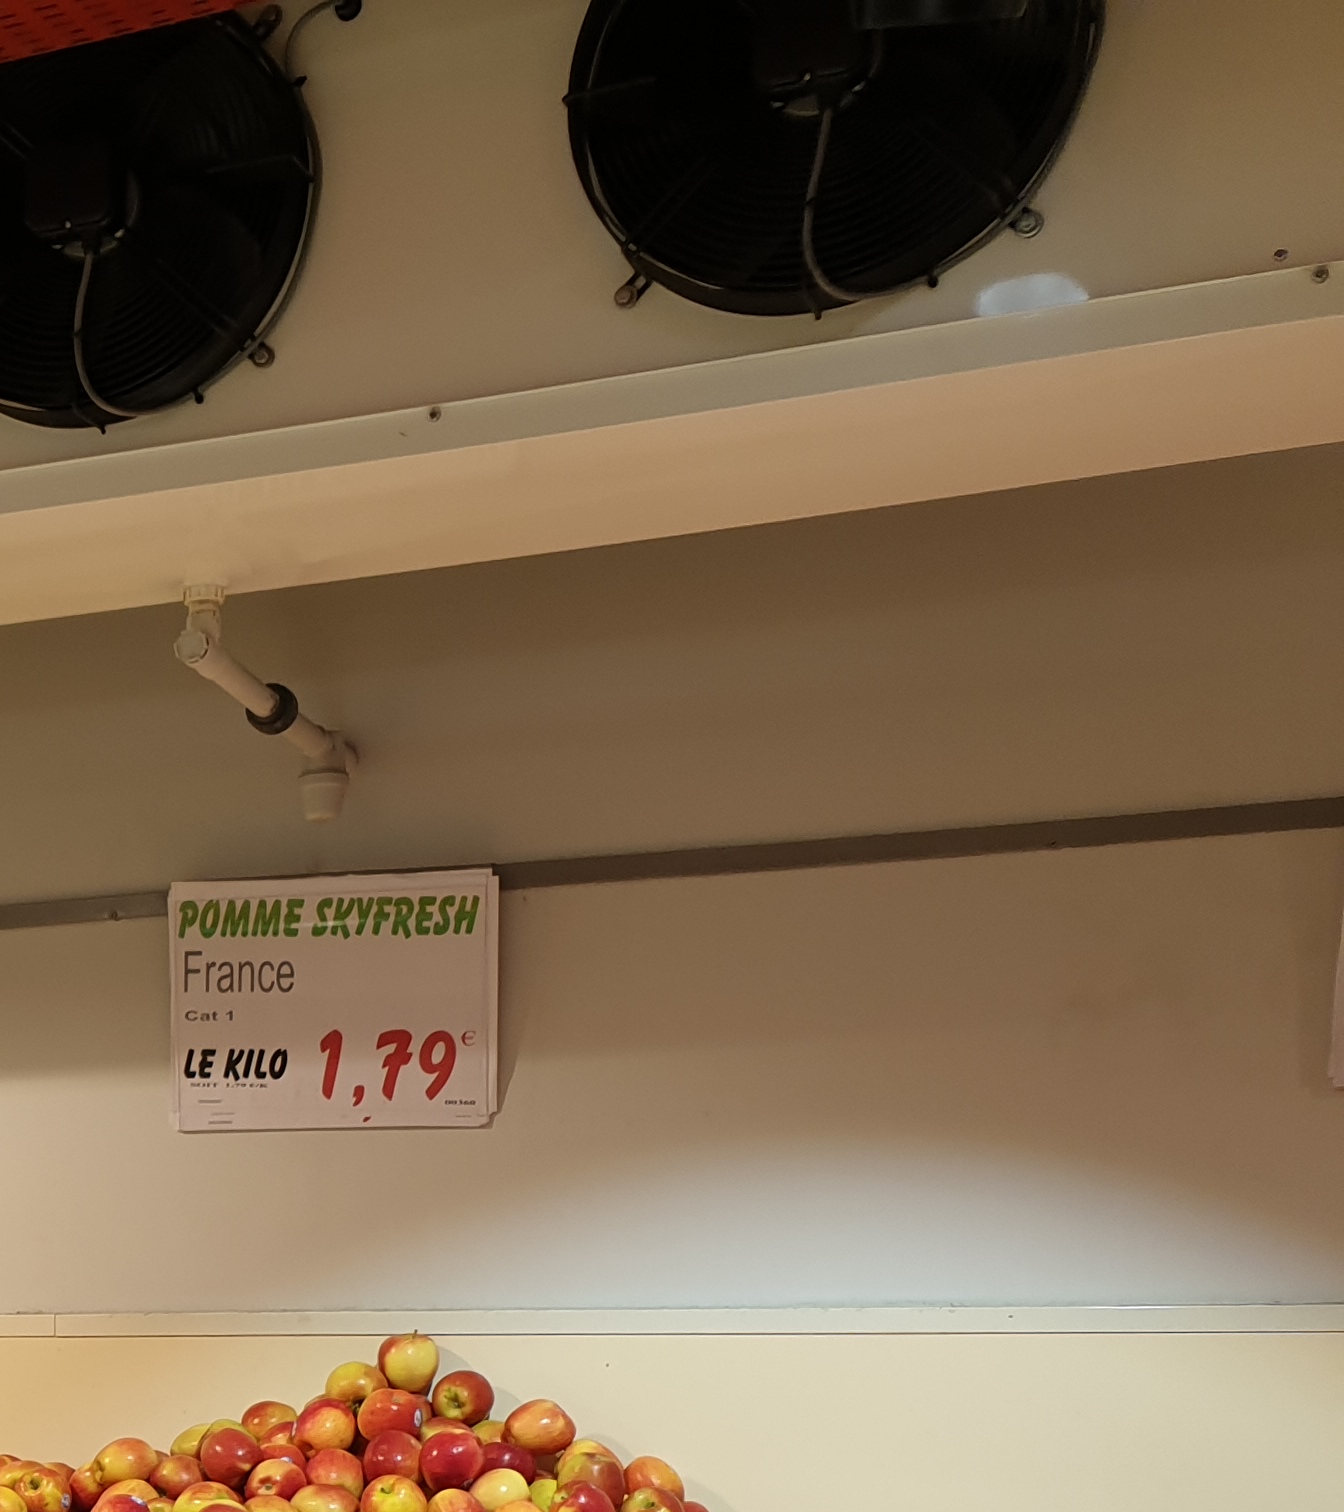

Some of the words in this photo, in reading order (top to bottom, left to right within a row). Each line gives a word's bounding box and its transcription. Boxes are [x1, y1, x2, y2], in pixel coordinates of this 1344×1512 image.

[178, 899, 305, 939] POMME
[311, 895, 480, 940] SKYFRESH
[183, 951, 295, 993] France
[184, 1010, 218, 1022] Cat
[225, 1010, 234, 1022] 1
[184, 1049, 216, 1080] LE
[223, 1048, 288, 1082] KILO
